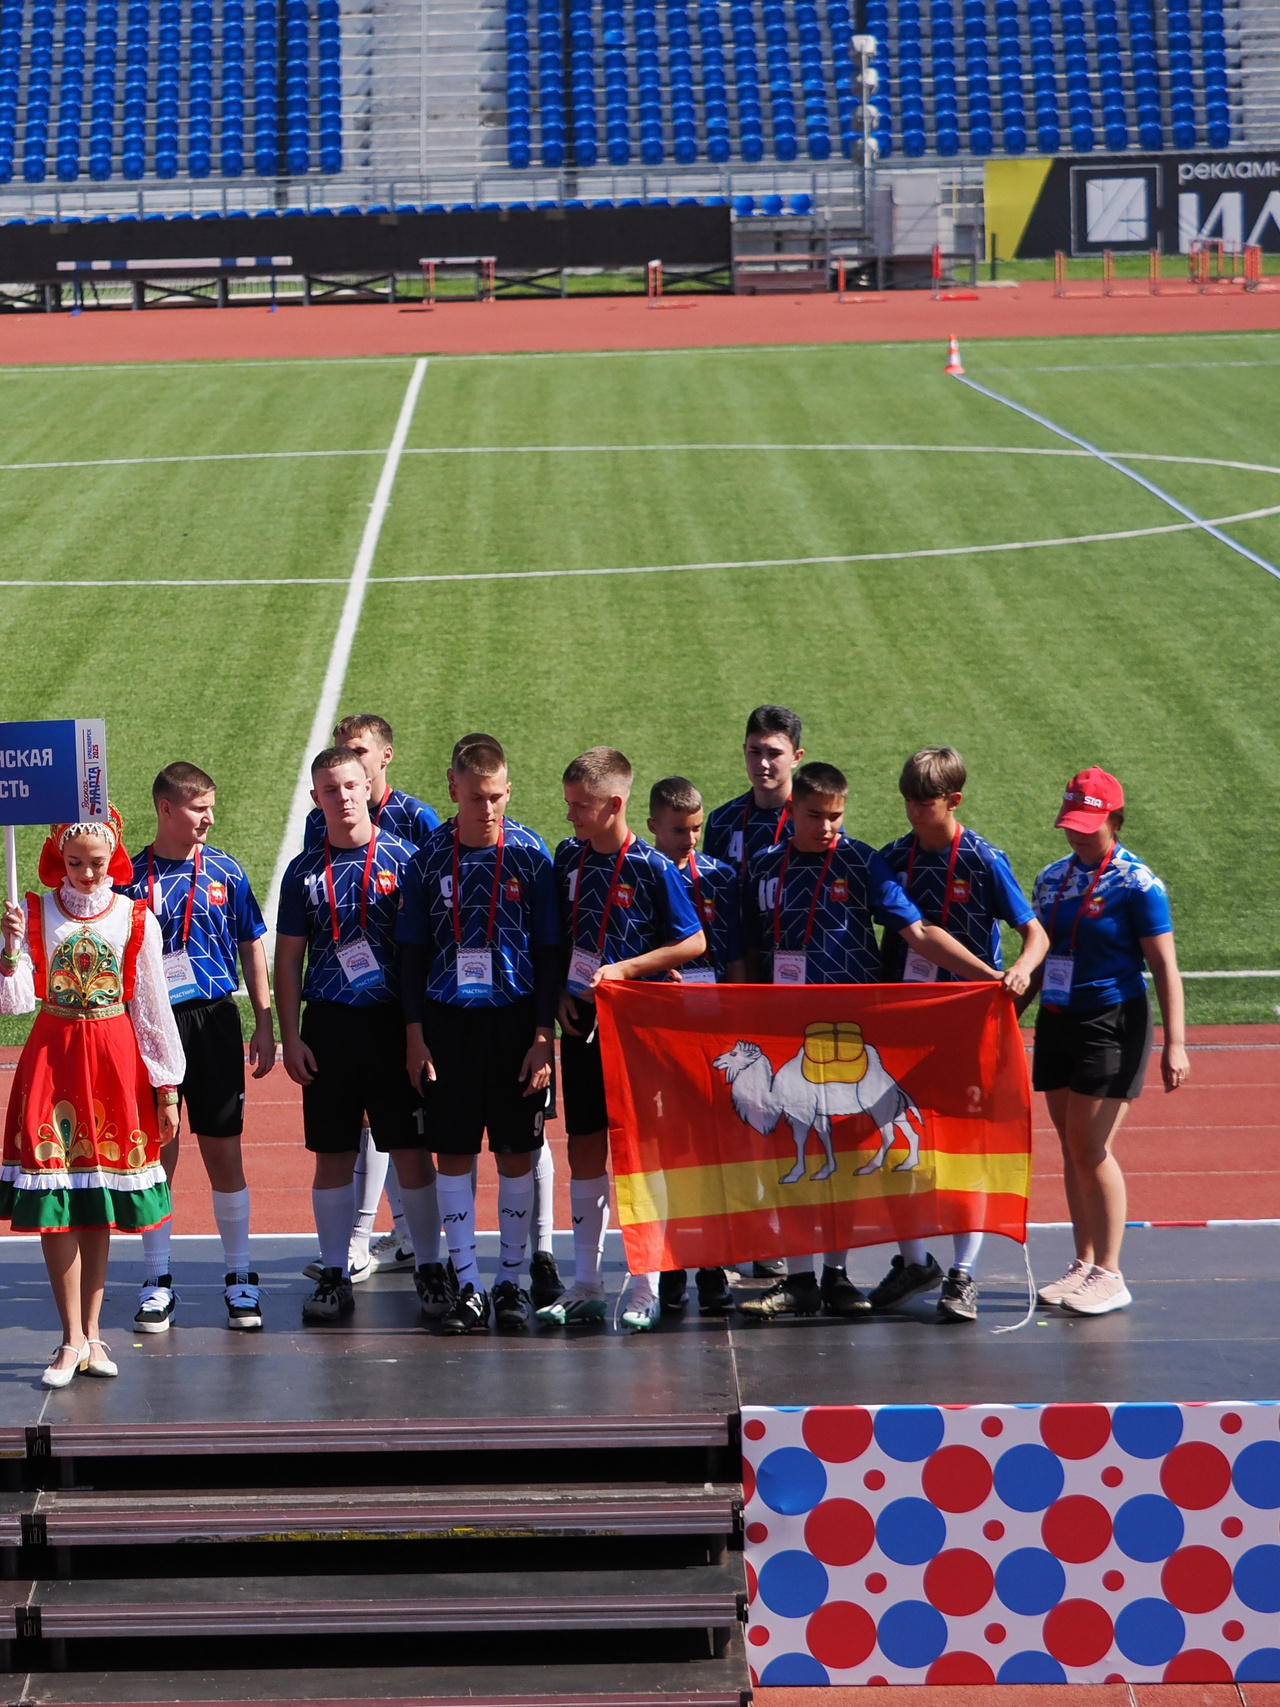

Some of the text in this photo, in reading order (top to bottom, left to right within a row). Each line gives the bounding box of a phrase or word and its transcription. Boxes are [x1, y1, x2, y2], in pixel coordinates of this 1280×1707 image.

[88, 766, 102, 806] ЛАПТА
[1083, 795, 1104, 809] SIA
[533, 1111, 544, 1137] 9
